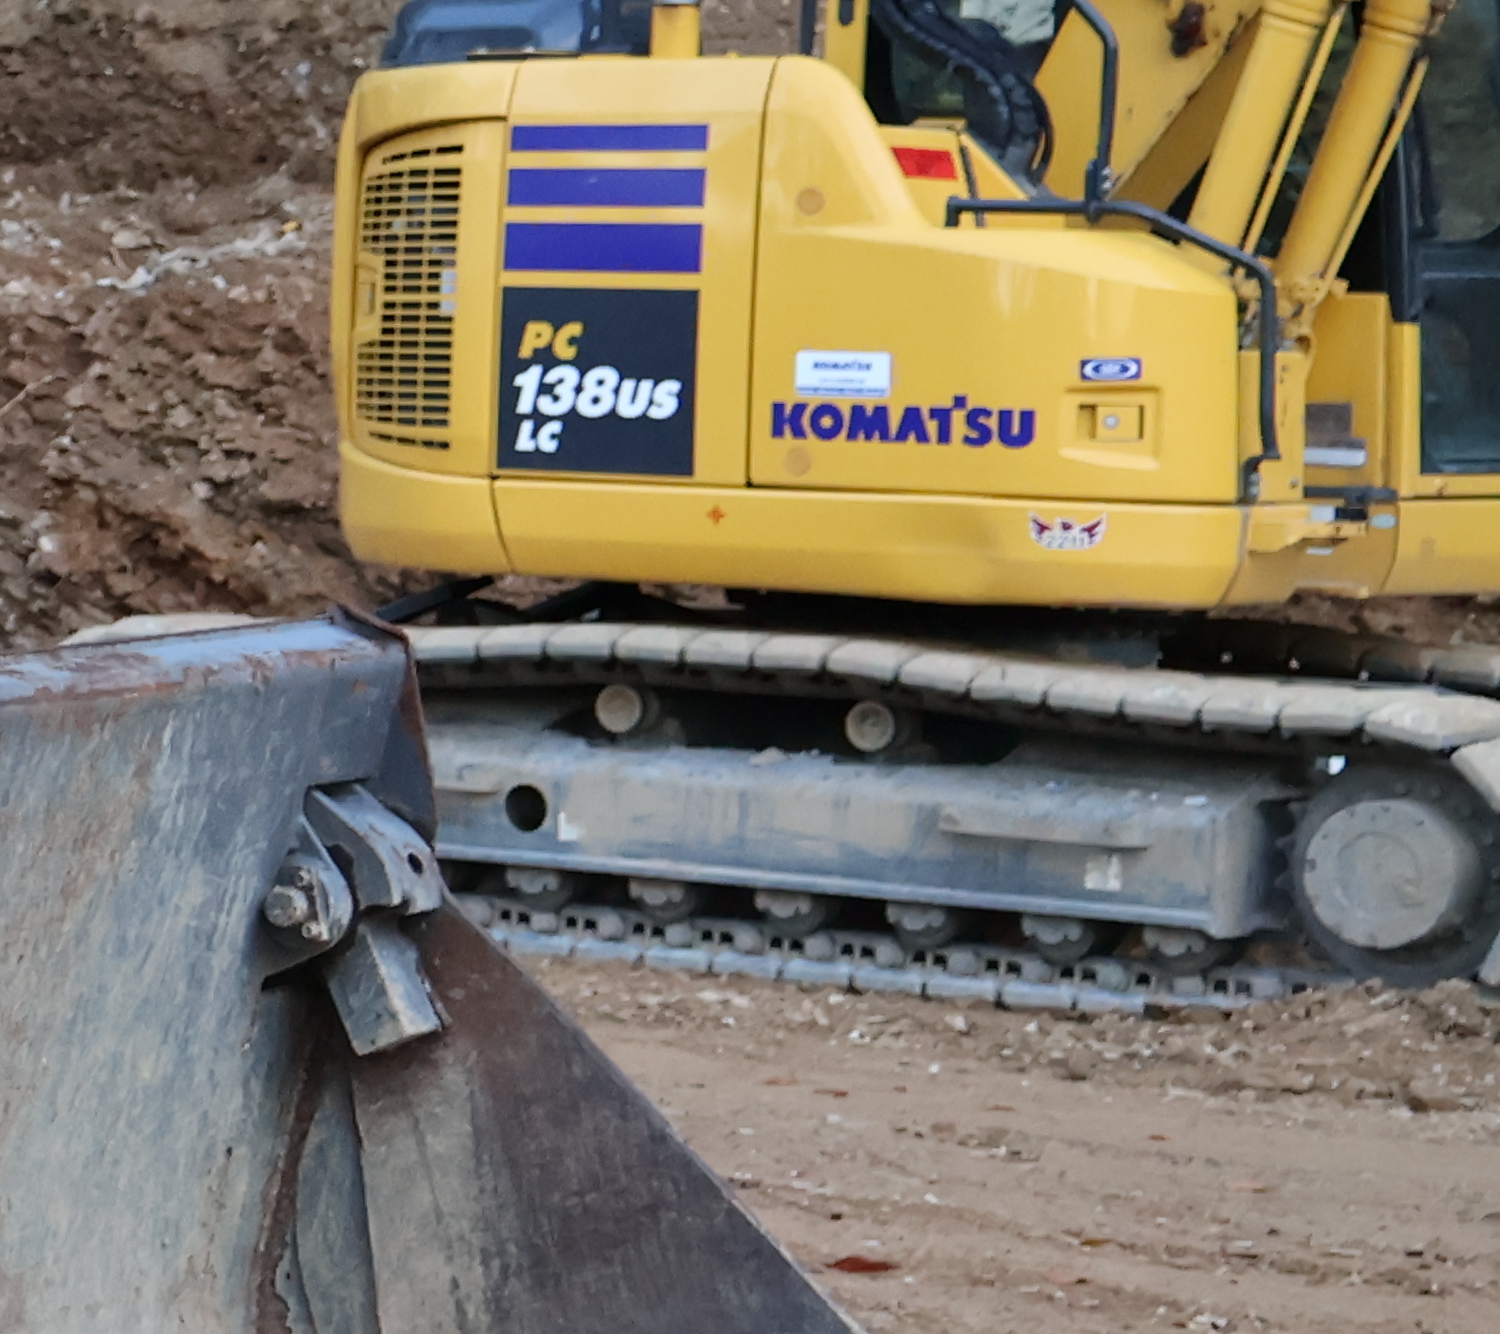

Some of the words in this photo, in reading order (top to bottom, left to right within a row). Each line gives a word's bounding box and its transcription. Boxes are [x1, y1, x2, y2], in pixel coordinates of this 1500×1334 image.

[518, 320, 584, 361] PC
[514, 419, 564, 454] LC
[771, 395, 1036, 448] KOMATSU
